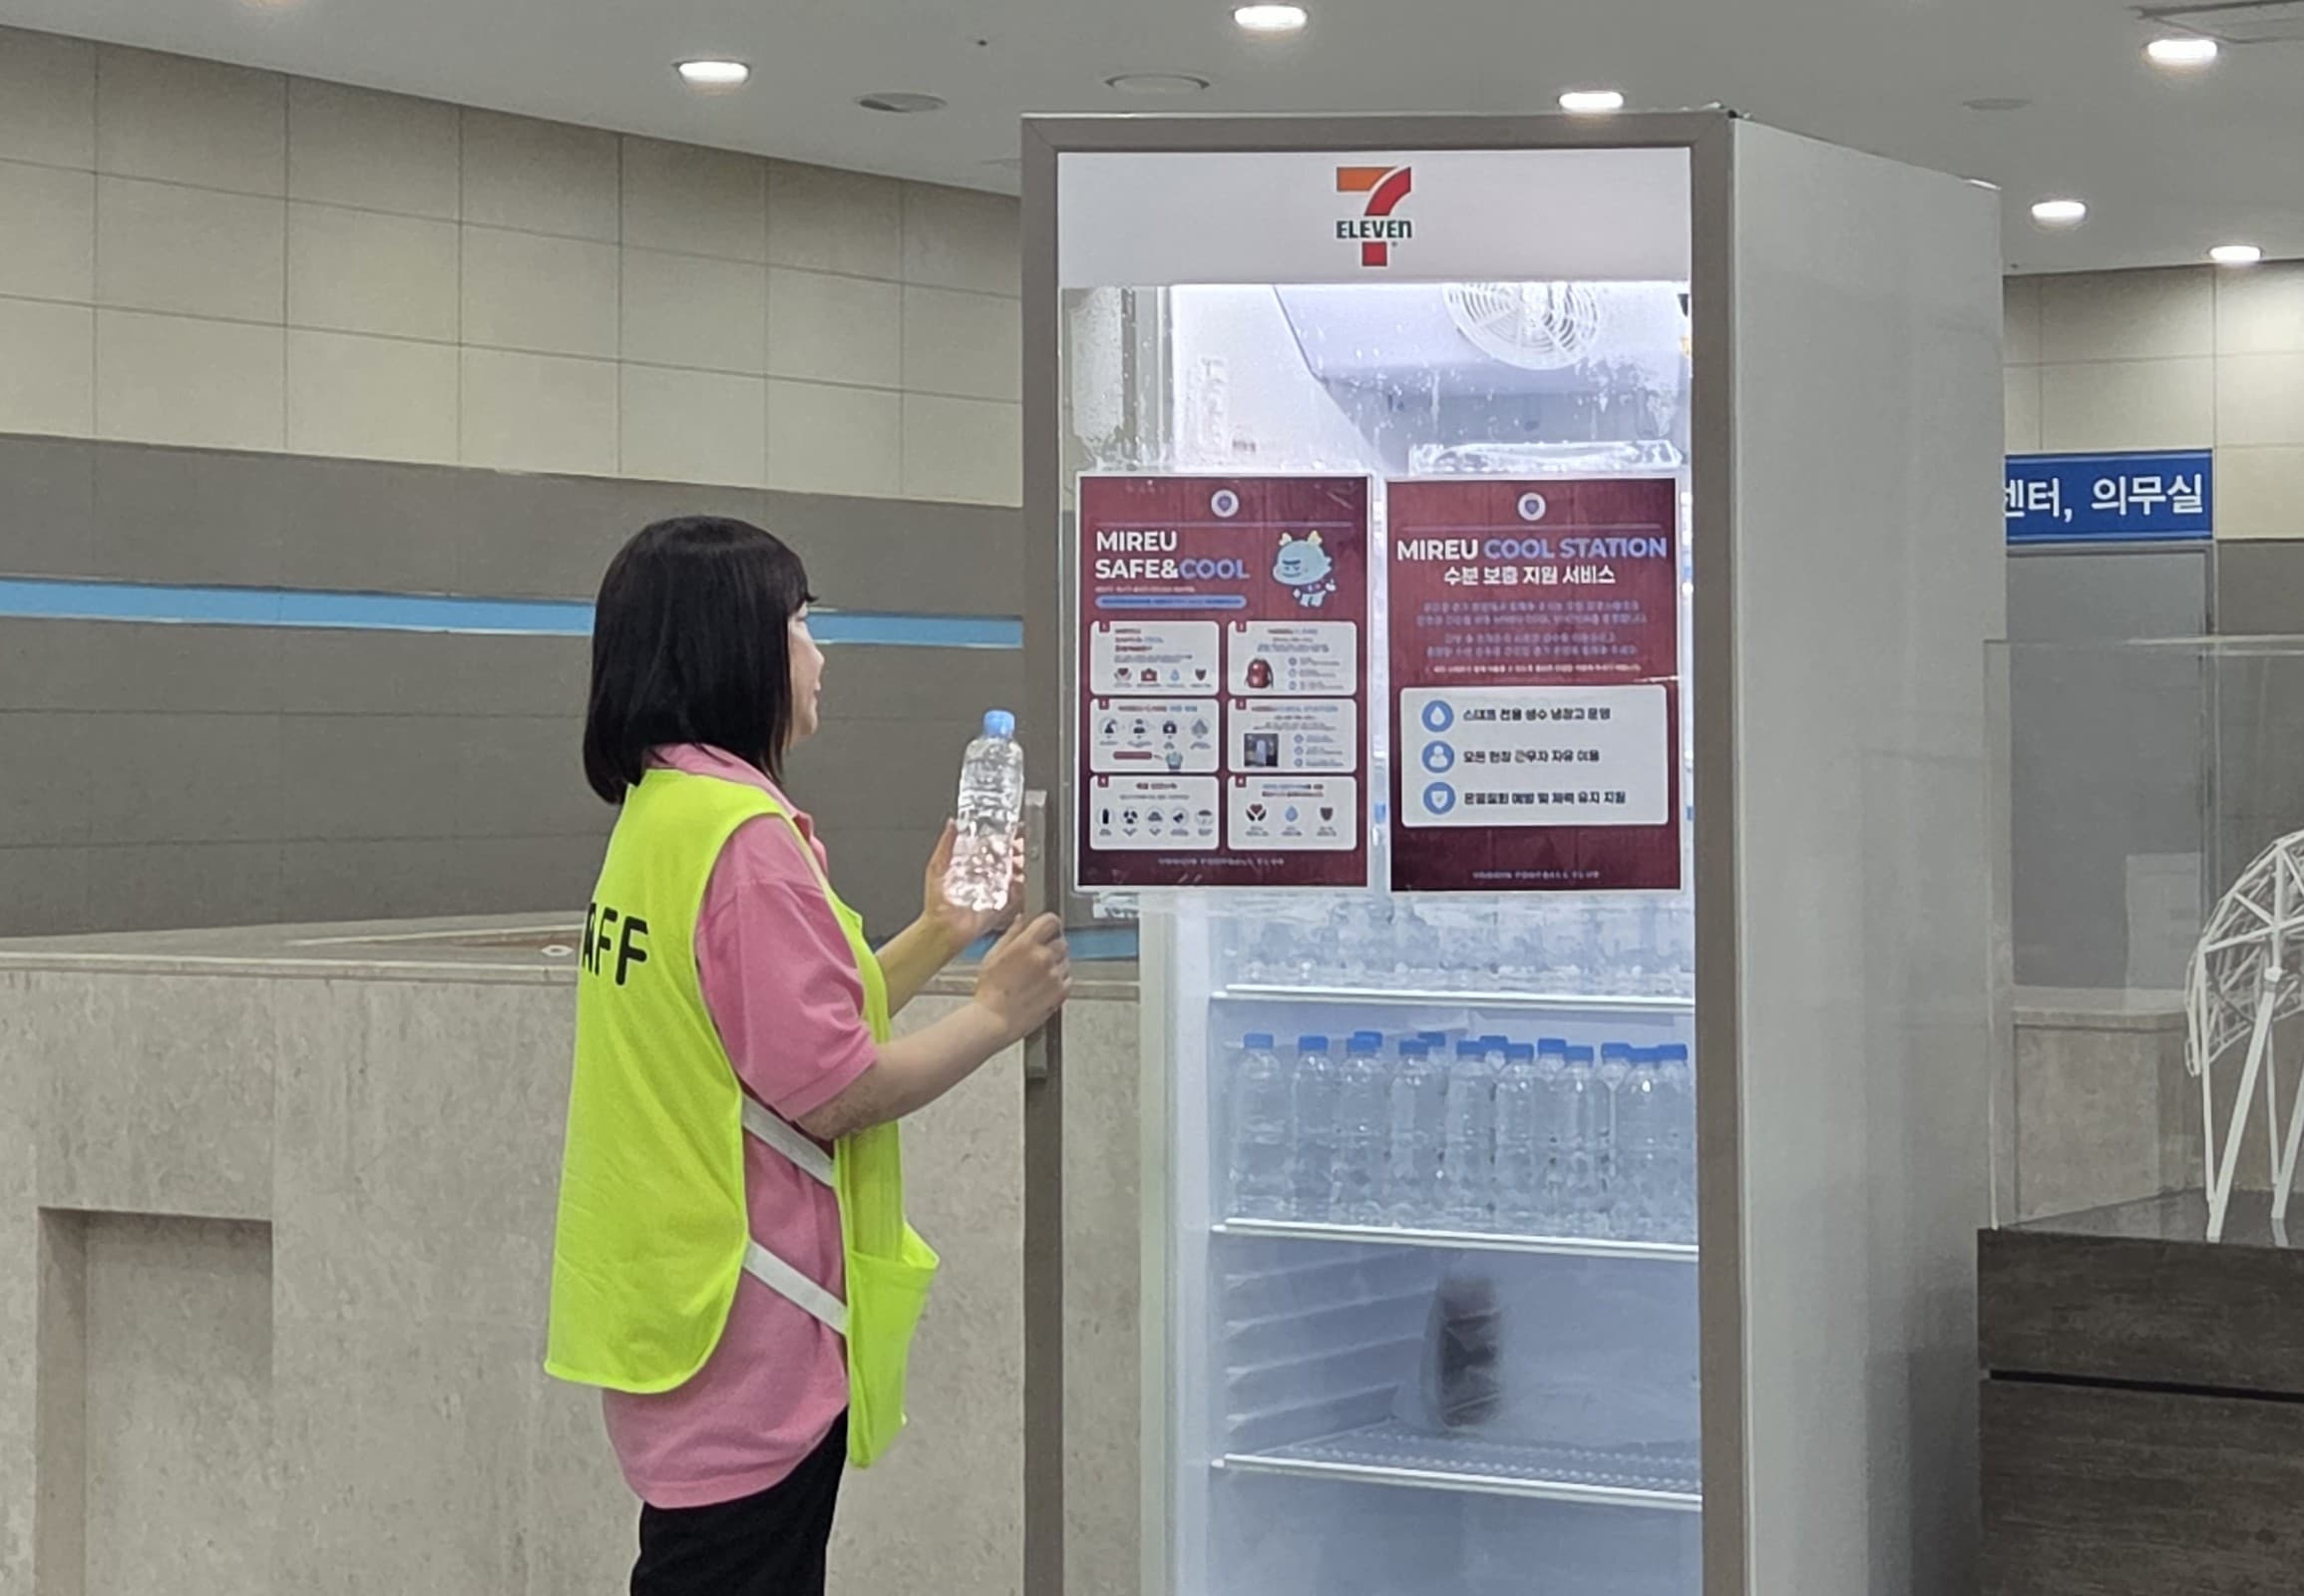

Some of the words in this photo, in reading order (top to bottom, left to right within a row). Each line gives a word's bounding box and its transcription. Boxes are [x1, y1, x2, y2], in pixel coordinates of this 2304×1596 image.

[2091, 474, 2203, 515] 의무실
[1096, 531, 1178, 552] MIREU
[1396, 540, 1478, 561] MIREU
[1483, 538, 1555, 560] COOL
[1559, 537, 1667, 559] STATION
[1094, 559, 1251, 580] SAFE&COOL
[1444, 566, 1478, 586] 수분
[1522, 566, 1558, 585] 지원
[1562, 565, 1616, 585] 서비스
